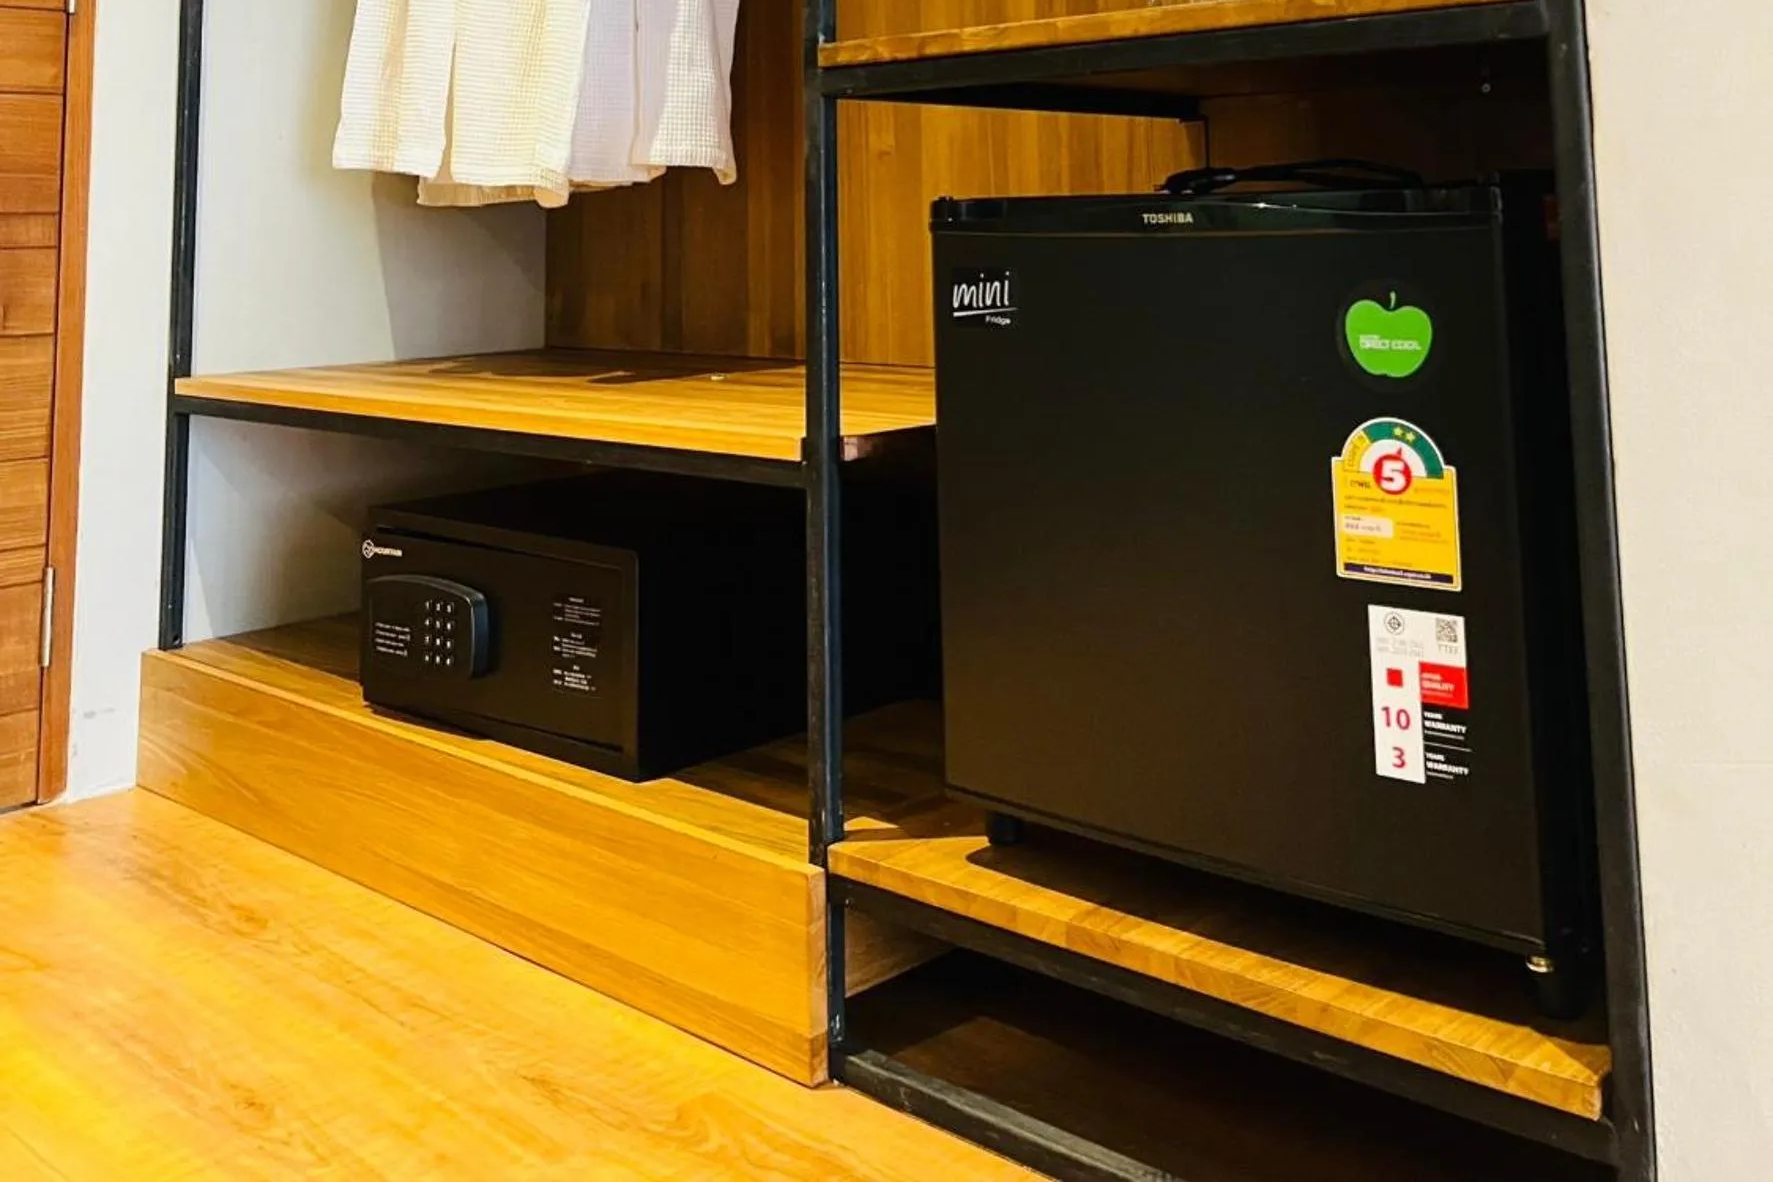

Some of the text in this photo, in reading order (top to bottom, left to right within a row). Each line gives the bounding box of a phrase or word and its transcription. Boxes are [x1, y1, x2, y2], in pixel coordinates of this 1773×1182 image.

[1142, 212, 1194, 224] TOSHIBA
[952, 270, 1010, 309] mini
[1380, 458, 1408, 493] 5
[1381, 706, 1411, 730] 10
[1424, 719, 1467, 733] WARRANTY
[1392, 746, 1406, 769] 3
